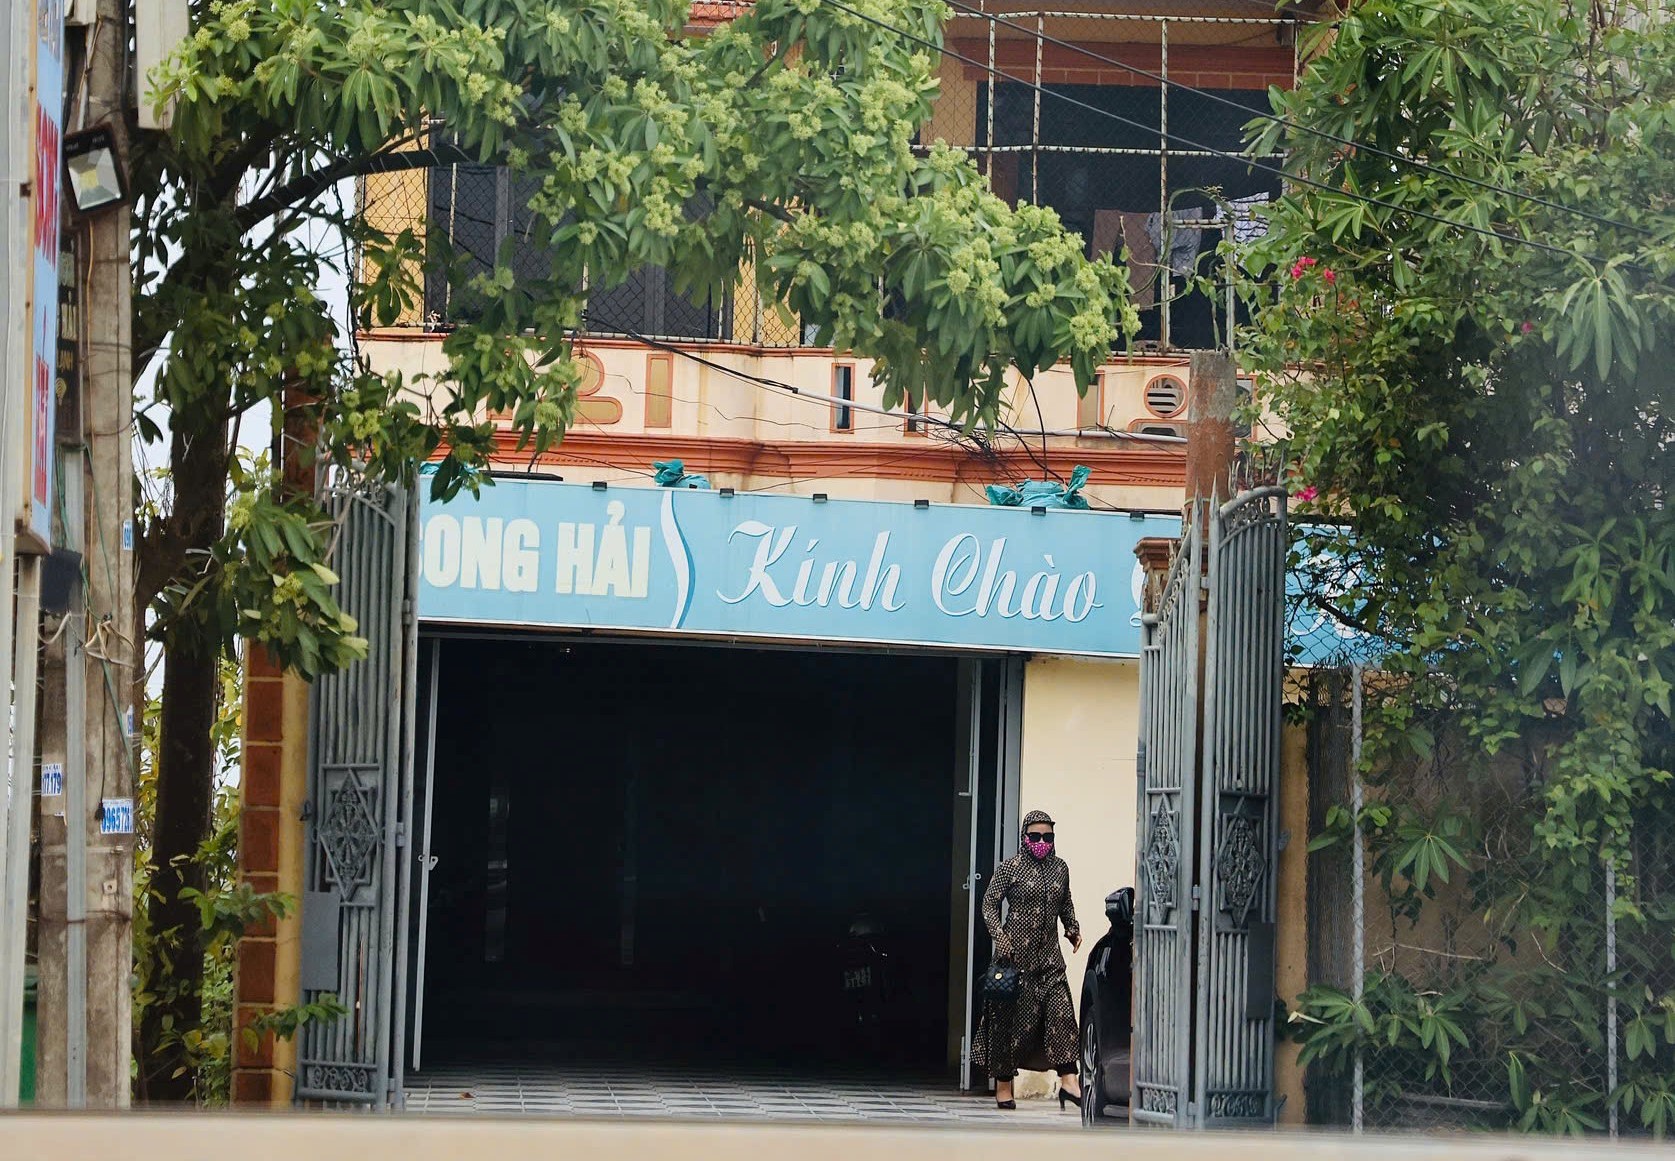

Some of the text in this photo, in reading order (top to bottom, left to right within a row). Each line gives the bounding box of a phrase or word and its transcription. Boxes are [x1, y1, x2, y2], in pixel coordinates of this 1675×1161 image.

[418, 500, 652, 598] ONG HẢI
[716, 519, 906, 613] Kính
[930, 532, 1104, 624] Chào
